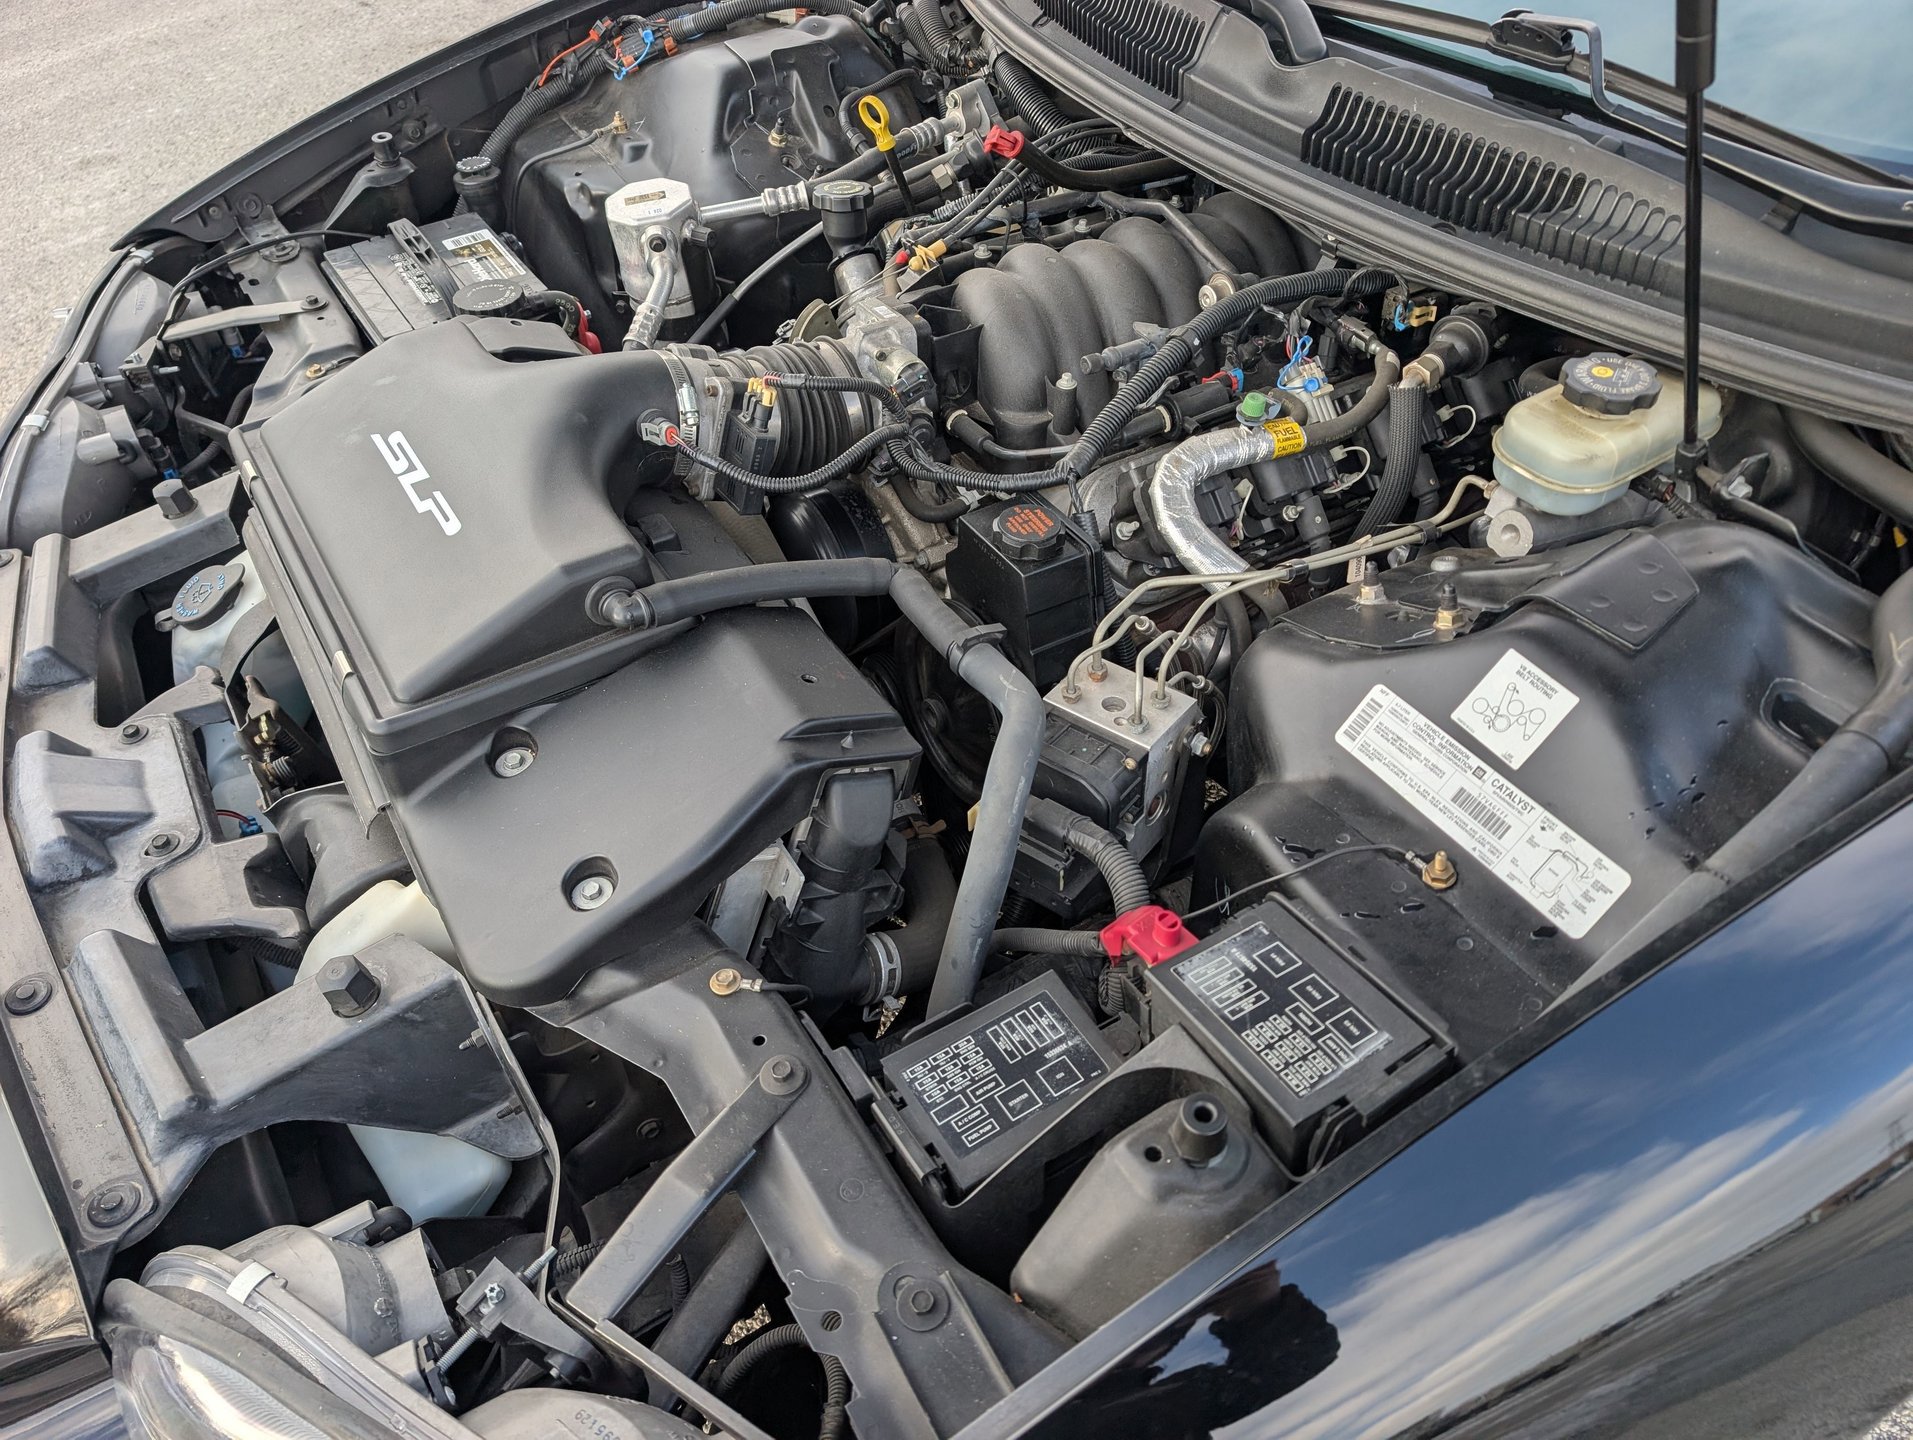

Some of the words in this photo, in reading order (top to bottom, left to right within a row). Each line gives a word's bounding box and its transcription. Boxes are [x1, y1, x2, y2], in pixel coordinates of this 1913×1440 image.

[1274, 427, 1298, 437] FUEL
[1277, 434, 1301, 443] FLAMMABLE
[1278, 443, 1302, 453] CAUTION
[370, 430, 462, 536] SLP
[179, 576, 199, 598] FLUID
[217, 573, 225, 590] ONLY
[176, 603, 199, 617] WASHER
[1515, 669, 1529, 681] BELT
[1528, 679, 1553, 699] ROUTING
[1526, 669, 1558, 695] ACCESSORY
[1411, 721, 1437, 742] CONTROL
[1436, 741, 1473, 771] INFORMATION
[1422, 721, 1446, 742] VEHICLE
[1444, 738, 1471, 760] EMISSION
[1411, 729, 1429, 743] GENERAL
[1442, 752, 1468, 774] CORPORATION
[1490, 777, 1536, 815] CATALYST
[1542, 816, 1558, 829] FRONT
[975, 1088, 984, 1096] AIR
[982, 1080, 996, 1091] PUMP
[1008, 1092, 1029, 1107] STARTER
[967, 1108, 982, 1120] COMP
[967, 1131, 980, 1141] FUEL
[978, 1123, 993, 1134] PUMP
[575, 1409, 620, 1440] 95129
